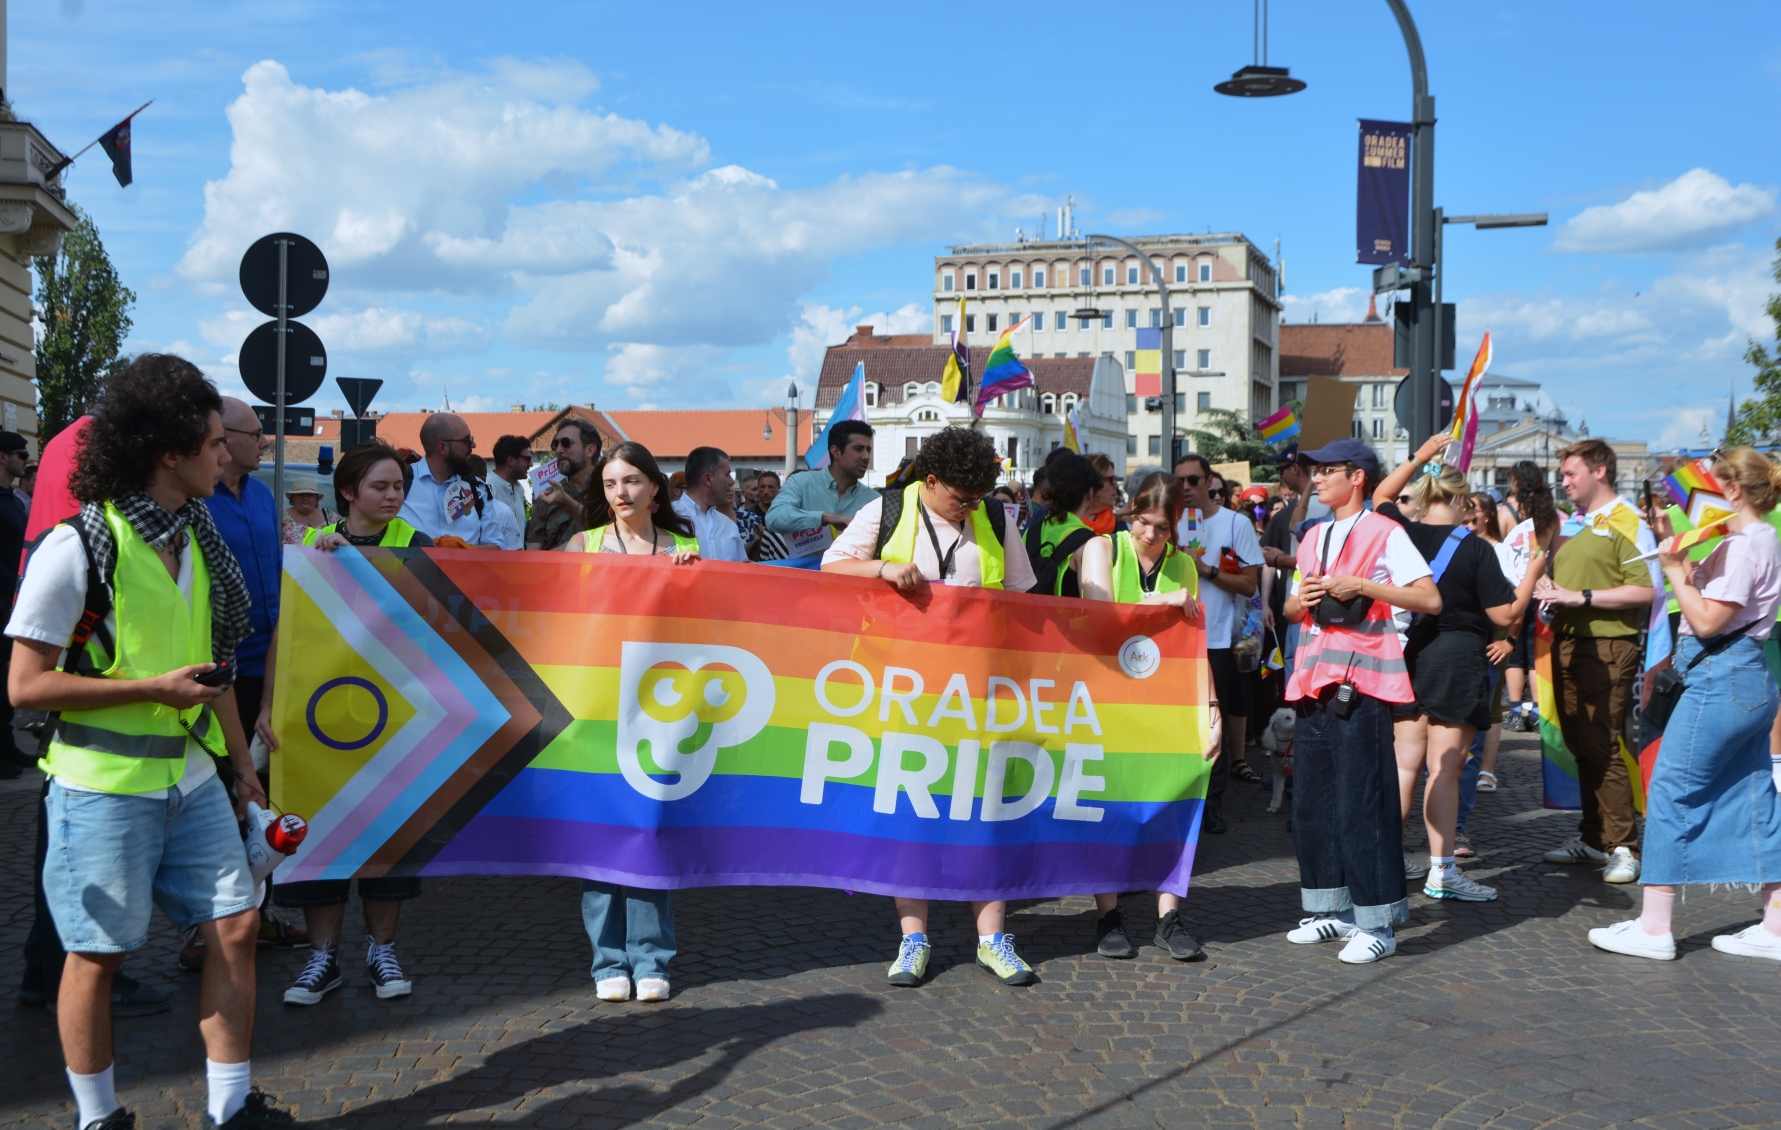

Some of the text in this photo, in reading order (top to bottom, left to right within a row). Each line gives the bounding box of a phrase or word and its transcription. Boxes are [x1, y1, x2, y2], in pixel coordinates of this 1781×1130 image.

[1364, 134, 1406, 148] ORADEA
[1382, 156, 1406, 169] FILM
[1130, 650, 1149, 662] Ark
[814, 659, 1103, 736] ORADEA
[800, 721, 1106, 823] PRIDE
